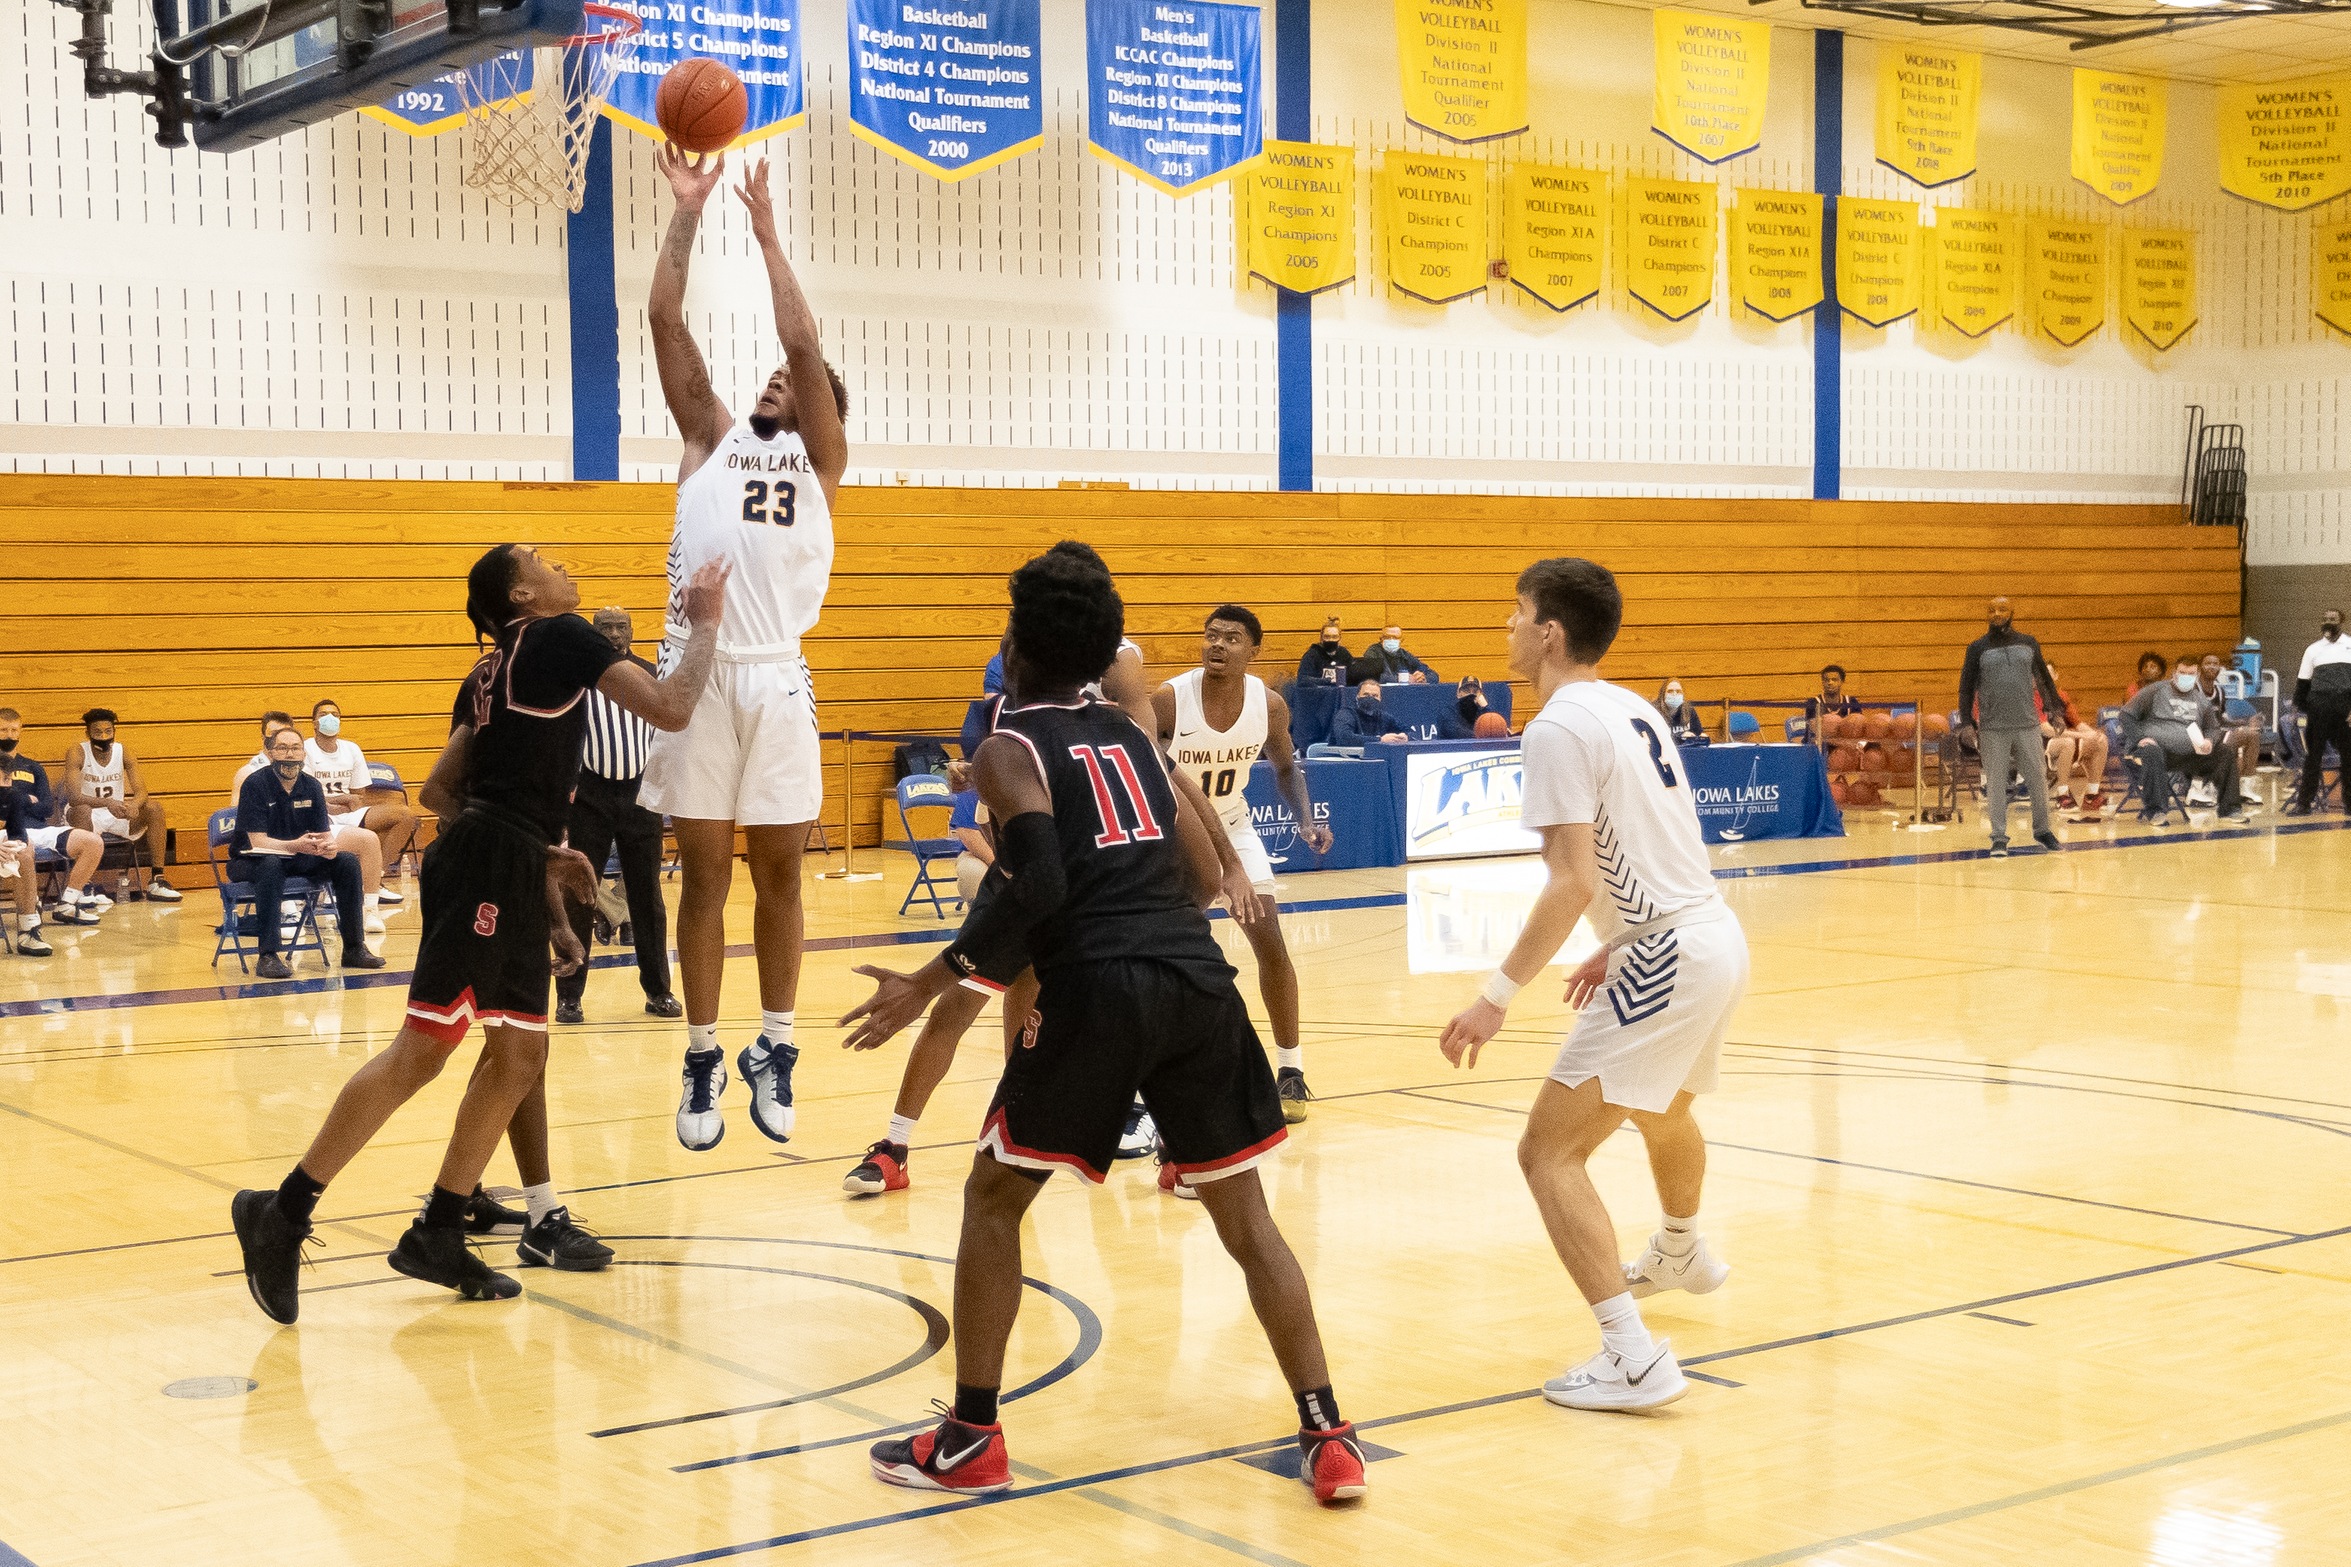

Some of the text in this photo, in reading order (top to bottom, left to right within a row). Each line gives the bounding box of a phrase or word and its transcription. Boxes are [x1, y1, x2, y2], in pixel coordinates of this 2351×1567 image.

[667, 3, 686, 22] XI
[691, 4, 791, 32] Champions
[903, 6, 987, 29] Basketball
[1156, 7, 1194, 24] Men's
[1420, 12, 1502, 33] VOLLEYBALL
[858, 25, 1031, 59] Region XI Champions
[1141, 28, 1208, 47] Basketball
[1684, 25, 1742, 43] WOMEN'S
[672, 32, 684, 49] 5
[689, 34, 788, 59] Champions
[1426, 34, 1480, 52] Division
[1677, 41, 1748, 62] VOLLEYBALL
[602, 53, 678, 76] Nationa
[1116, 46, 1234, 72] ICCAC Champions
[1433, 55, 1491, 74] National
[1905, 53, 1957, 72] WOMEN'S
[861, 51, 1029, 85] District 4 Champions
[1682, 60, 1730, 77] Division
[1106, 67, 1243, 94] Region XI Champions
[1421, 70, 1503, 91] Tournament
[1687, 80, 1738, 97] National
[1897, 70, 1961, 90] VOLLEYBALL
[398, 91, 445, 111] 1992
[861, 79, 1030, 109] National Tournament
[1108, 90, 1241, 115] District 8 Champions
[1434, 91, 1489, 109] Qualifier
[1902, 88, 1945, 104] Division
[2256, 90, 2332, 105] WOMEN'S
[1677, 95, 1748, 115] Tournament
[1907, 106, 1952, 121] National
[2246, 105, 2340, 121] VOLLEYBALL
[908, 112, 986, 133] Qualifiers
[1109, 112, 1241, 136] National Tournament
[1445, 111, 1476, 127] 2005
[1685, 115, 1740, 131] 10th Place
[1896, 121, 1961, 138] Tournament
[2252, 125, 2316, 137] Division
[928, 140, 968, 158] 2000
[1145, 138, 1208, 155] Qualifiers
[2260, 137, 2327, 151] National
[1162, 161, 1193, 176] 2013
[1268, 153, 1334, 169] WOMEN'S
[2247, 155, 2340, 168] Tournament
[1405, 164, 1466, 181] WOMEN'S
[2260, 171, 2324, 182] 5th Place
[1260, 175, 1342, 194] VOLLEYBALL
[1530, 176, 1589, 192] WOMEN'S
[2276, 186, 2310, 198] 2010
[1397, 186, 1472, 206] VOLLEYBALL
[1645, 191, 1700, 204] WOMEN'S
[1269, 201, 1335, 218] Region XI
[1525, 199, 1597, 217] VOLLEYBALL
[1754, 201, 1807, 215] WOMEN'S
[1854, 208, 1904, 223] WOMEN'S
[1408, 212, 1464, 228] District C
[1639, 213, 1708, 228] VOLLEYBALL
[1951, 220, 1998, 232] WOMEN'S
[1264, 225, 1337, 244] Champions
[1526, 222, 1565, 238] Region
[1747, 222, 1810, 237] VOLLEYBALL
[1847, 229, 1908, 245] VOLLEYBALL
[1400, 235, 1468, 253] Champions
[1648, 235, 1699, 249] District C
[1528, 246, 1593, 263] Champions
[1748, 243, 1785, 259] Region
[1853, 251, 1899, 264] District C
[1286, 254, 1318, 269] 2005
[1644, 259, 1706, 275] Champions
[1420, 264, 1450, 278] 2005
[1750, 265, 1807, 280] Champions
[1547, 274, 1573, 286] 2007
[1662, 285, 1688, 297] 2007
[768, 453, 810, 473] LAKE
[742, 480, 796, 528] 23
[1178, 744, 1259, 764] IOWA LAKES
[1630, 717, 1678, 791] 2
[333, 770, 352, 778] LAKES
[1200, 769, 1236, 798] 10
[1068, 744, 1164, 848] 11
[1692, 785, 1779, 803] IOWA LAKES
[1697, 805, 1779, 816] OMMUNITY COLLEGE
[474, 902, 498, 936] S
[1023, 1009, 1042, 1049] S
